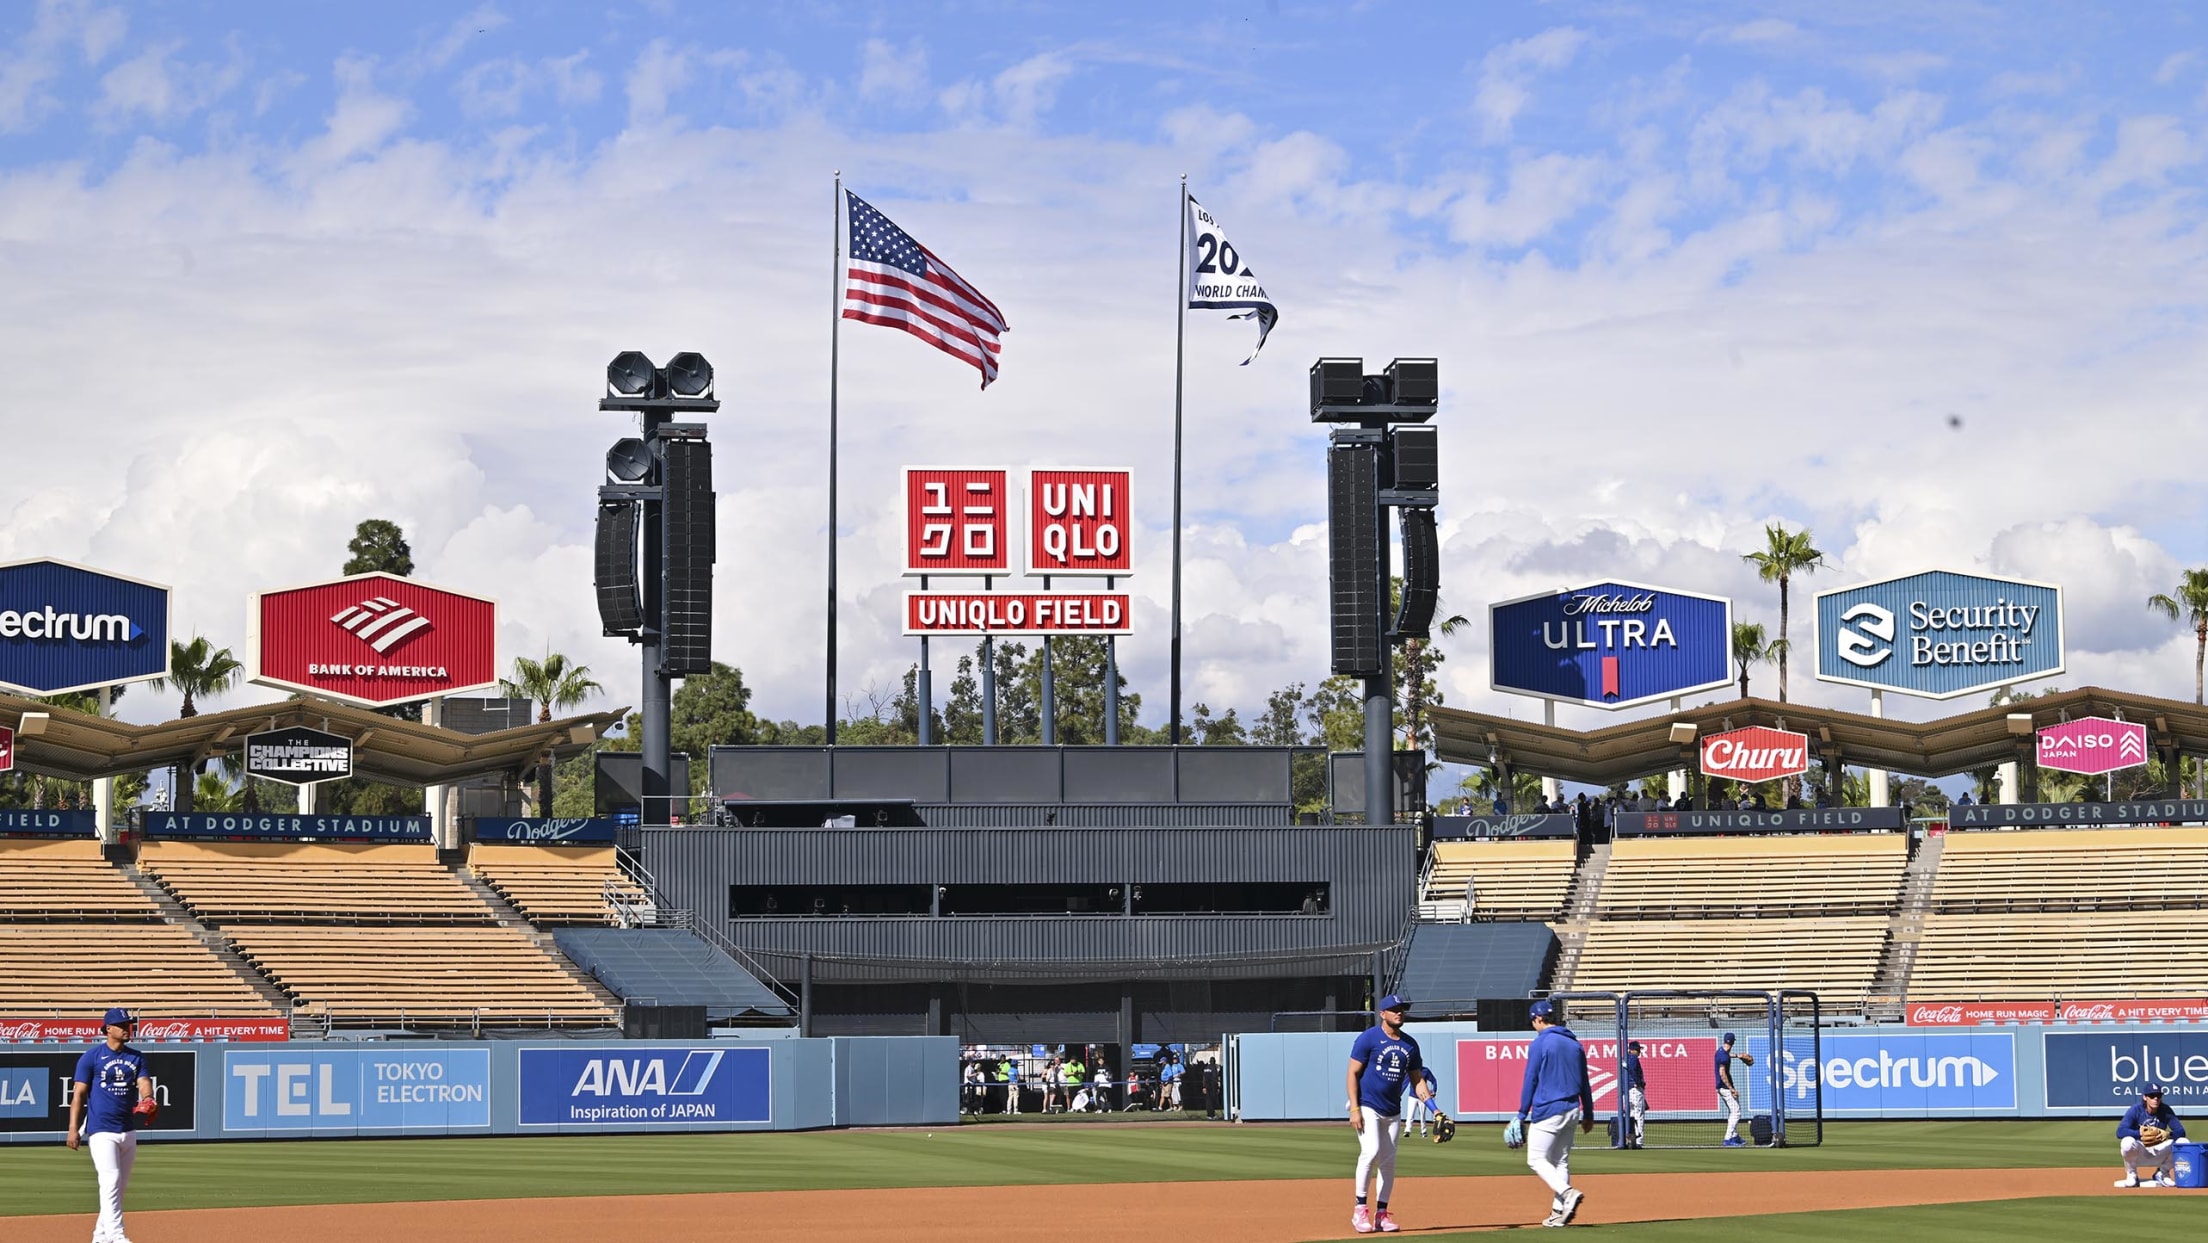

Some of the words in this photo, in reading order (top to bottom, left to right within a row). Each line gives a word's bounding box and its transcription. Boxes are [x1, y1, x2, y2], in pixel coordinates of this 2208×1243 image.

[1195, 232, 1255, 278] 20
[1195, 284, 1232, 298] WORLD
[1236, 285, 1269, 300] CHAM
[921, 482, 994, 514] ユニ
[1043, 483, 1111, 516] UNI
[920, 523, 994, 556] クロ
[1044, 523, 1119, 562] QLO
[1563, 593, 1656, 616] Michelob
[0, 605, 130, 642] ectrum
[919, 599, 1025, 630] UNIQLO
[1035, 599, 1121, 625] FIELD
[1909, 598, 2039, 634] Security
[1543, 618, 1677, 649] ULTRA
[1911, 633, 2023, 665] Benefit
[308, 663, 352, 676] BANK
[354, 664, 376, 676] OF
[377, 664, 448, 677] AMERICA
[2042, 734, 2113, 750] DAISO
[250, 745, 349, 759] CHAMPIONS
[1705, 739, 1804, 770] Churu
[2042, 750, 2077, 758] JAPAN
[250, 757, 349, 772] COLLECTIVE
[0, 813, 60, 828] IELD
[1691, 813, 1783, 827] UNIQLO
[1799, 812, 1863, 825] FIELD
[1964, 809, 1990, 822] AT
[2006, 806, 2102, 821] DODGER
[2118, 804, 2204, 818] STADIU
[165, 816, 191, 830] AT
[206, 816, 302, 832] DODGER
[316, 818, 421, 833] STADIUM
[1913, 1006, 1964, 1023] Coca-Cola
[1966, 1010, 1994, 1018] HOME
[1996, 1010, 2017, 1018] RUN
[2018, 1010, 2049, 1018] MAGIC
[2063, 1004, 2115, 1019] Coca-Cola
[2118, 1008, 2126, 1017] A
[2128, 1008, 2145, 1016] HIT
[2147, 1007, 2182, 1016] EVERY
[2183, 1007, 2208, 1015] TIME
[0, 1022, 42, 1038] oca-Cola
[44, 1027, 74, 1035] HOME
[75, 1027, 96, 1035] RUN
[140, 1022, 191, 1038] Coca-Cola
[194, 1026, 202, 1035] A
[204, 1026, 221, 1035] HIT
[223, 1026, 256, 1035] EVERY
[259, 1026, 284, 1035] TIME
[1485, 1045, 1529, 1060] BAN
[1587, 1043, 1688, 1059] AMRICA
[374, 1062, 443, 1081] TOKYO
[2111, 1045, 2208, 1082] blue
[571, 1059, 666, 1096] ANA
[1766, 1049, 1983, 1099] Spectrum
[1, 1079, 36, 1105] LA
[232, 1063, 351, 1117] TEL
[377, 1084, 482, 1103] ELECTRON
[2112, 1086, 2208, 1096] CALORNIA
[570, 1104, 648, 1121] Inspiration
[650, 1103, 667, 1118] of
[669, 1103, 716, 1118] JAPAN
